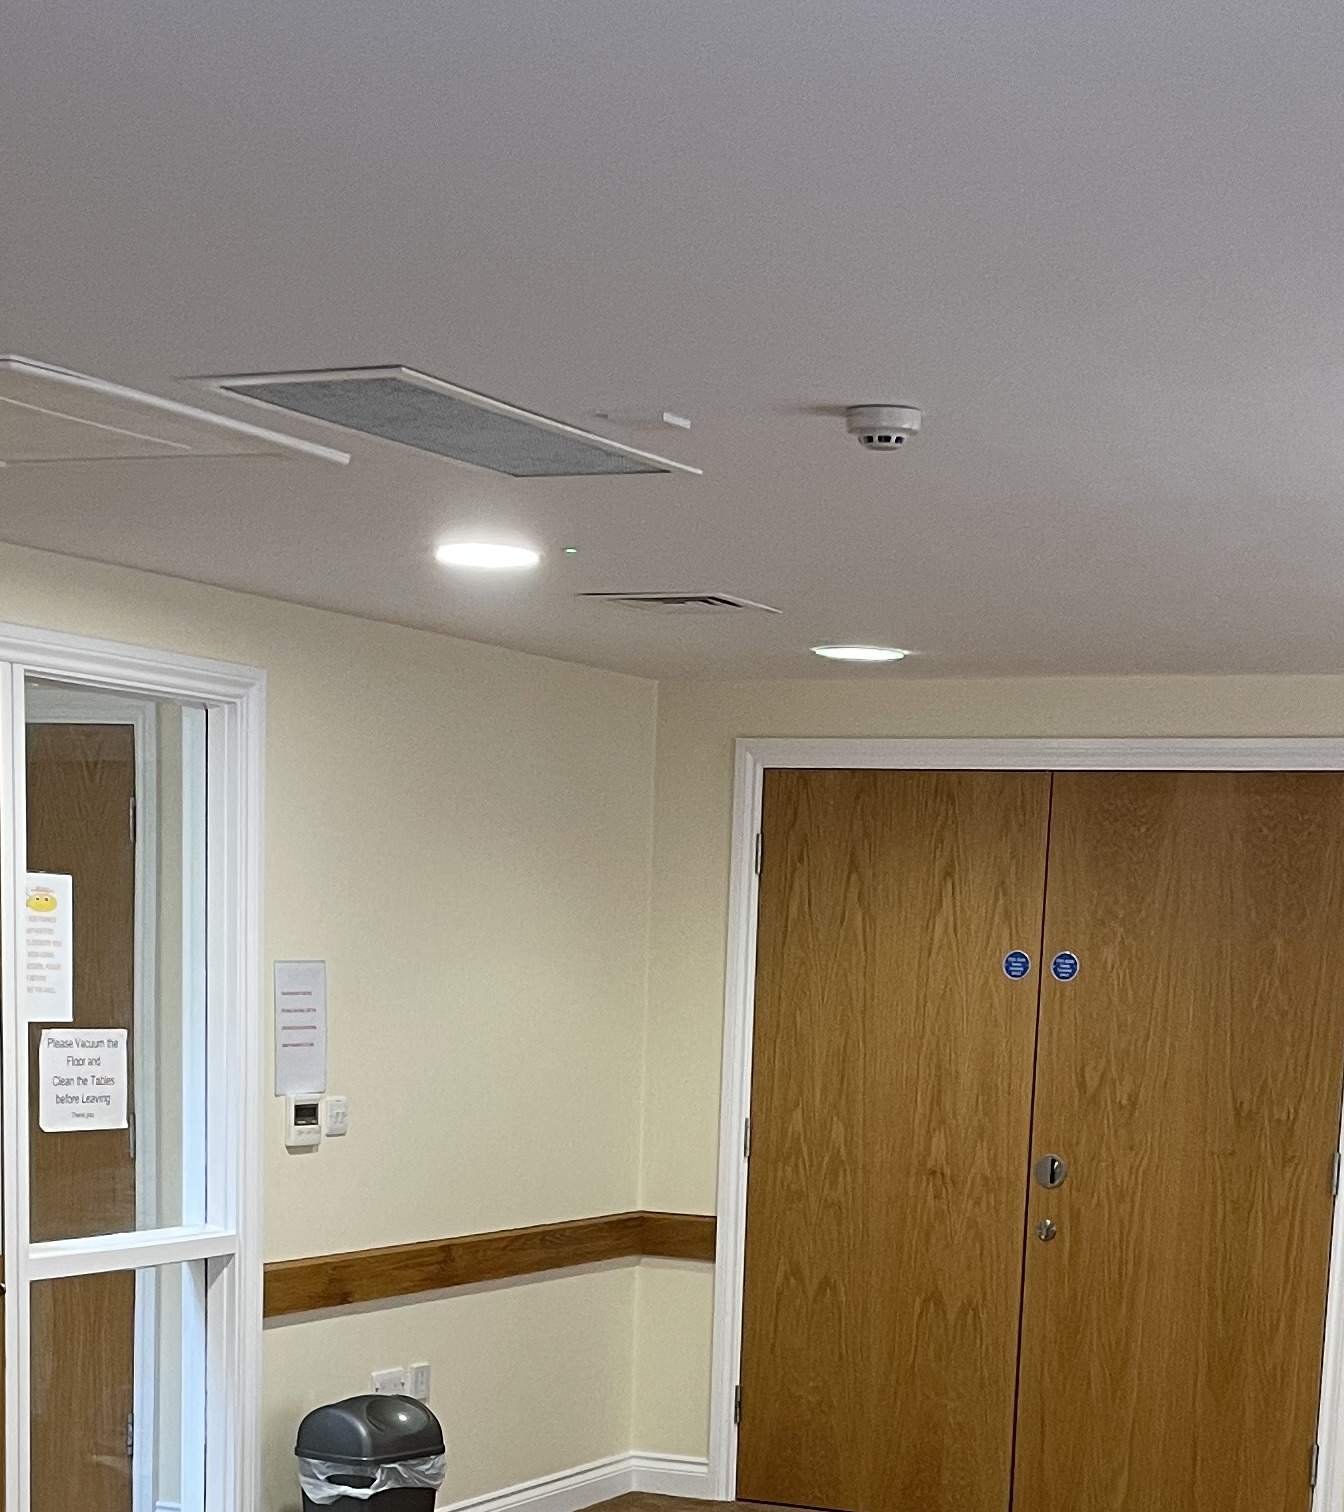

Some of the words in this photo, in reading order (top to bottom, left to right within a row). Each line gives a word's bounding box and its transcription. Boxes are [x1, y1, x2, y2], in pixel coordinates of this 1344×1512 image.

[47, 1038, 73, 1049] Please
[74, 1038, 105, 1049] Vacuum
[106, 1038, 118, 1049] the
[66, 1056, 86, 1066] Floor
[87, 1056, 101, 1066] and
[52, 1075, 74, 1086] Clean
[76, 1076, 88, 1086] the
[90, 1075, 115, 1086] Tables
[55, 1093, 79, 1104] before
[81, 1093, 111, 1106] Leaving
